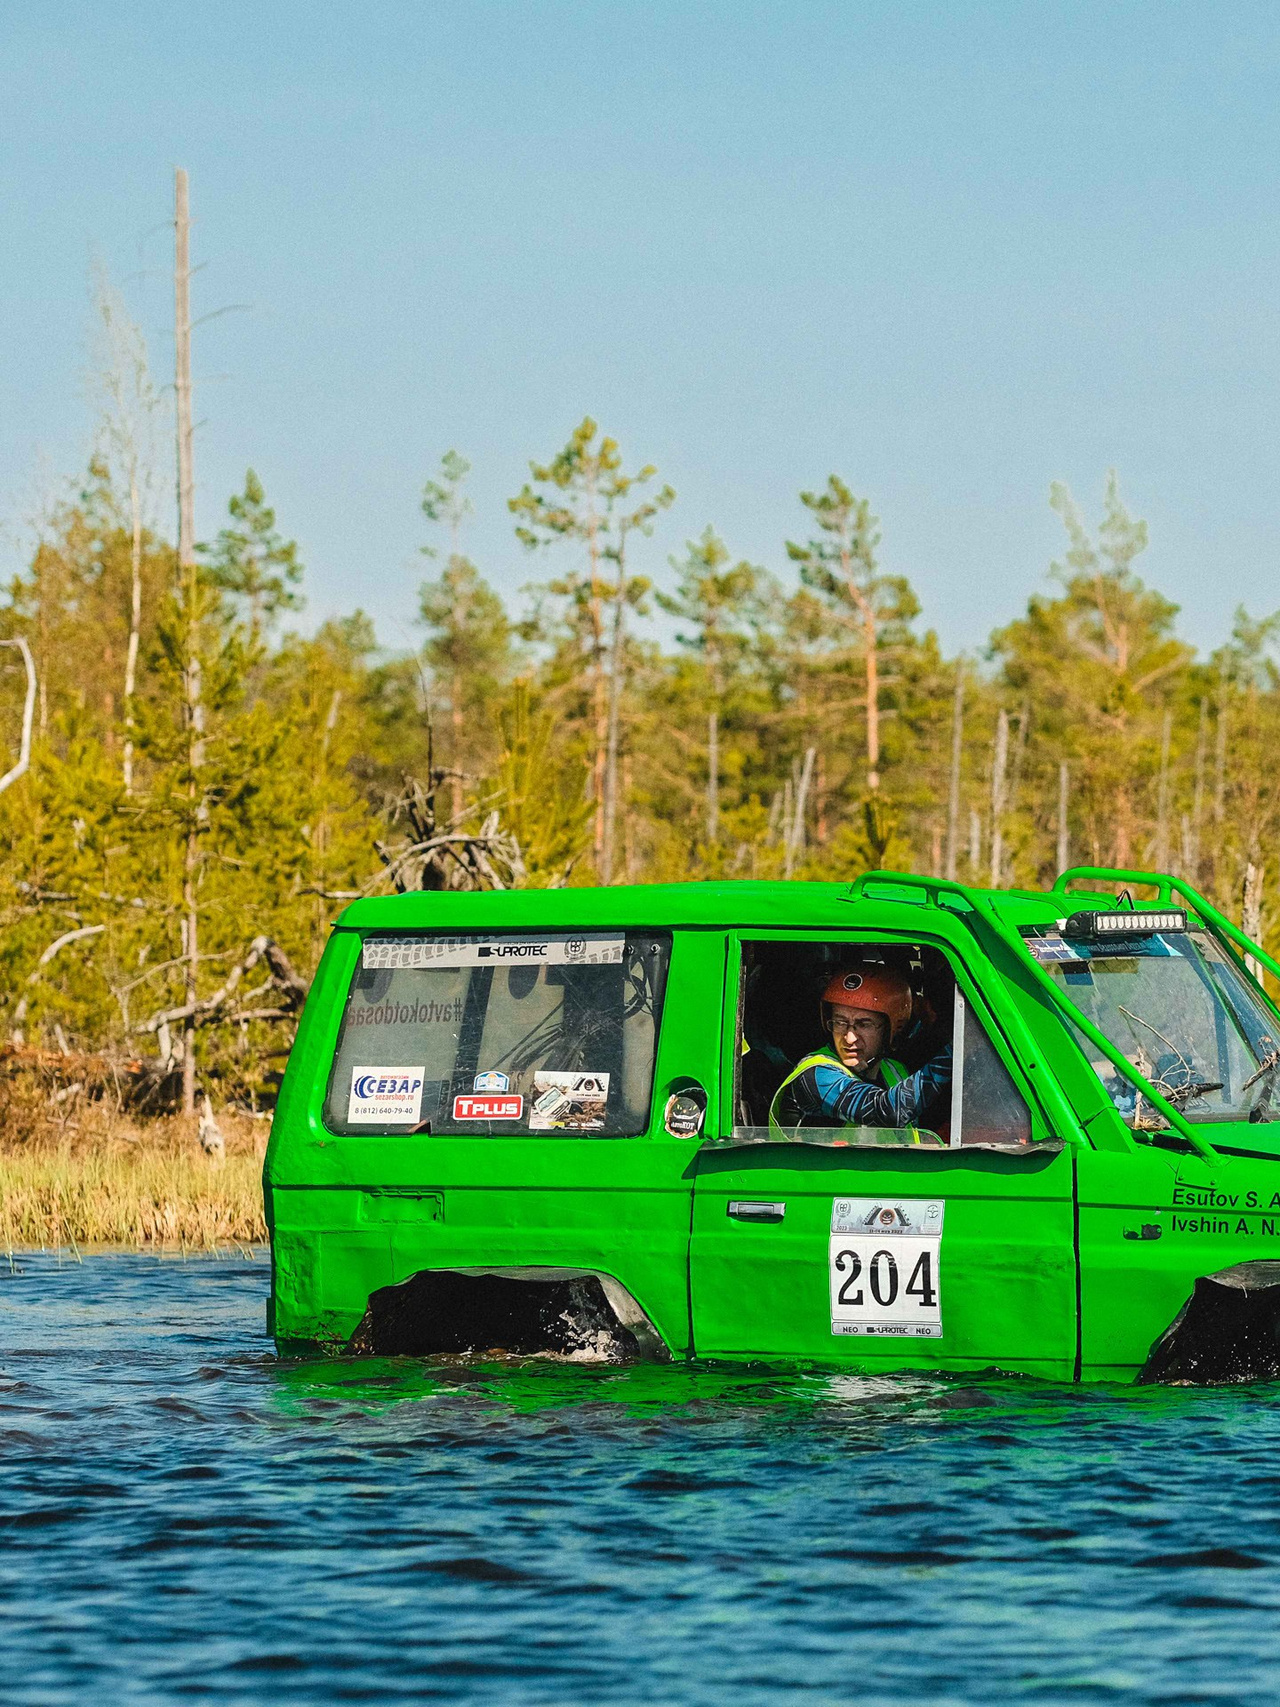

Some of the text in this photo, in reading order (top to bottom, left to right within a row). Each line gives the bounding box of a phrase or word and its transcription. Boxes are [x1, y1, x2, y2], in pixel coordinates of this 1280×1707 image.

[489, 945, 548, 957] SUPROTEC
[366, 1079, 422, 1094] СЕЗАР
[374, 1094, 415, 1102] sezarshop.ru
[360, 1107, 378, 1115] (812)
[1172, 1189, 1239, 1207] Esutov
[1245, 1191, 1263, 1209] S.
[1171, 1215, 1280, 1237] Ivshin A. N.
[835, 1249, 937, 1307] 204
[915, 1327, 932, 1335] NEO
